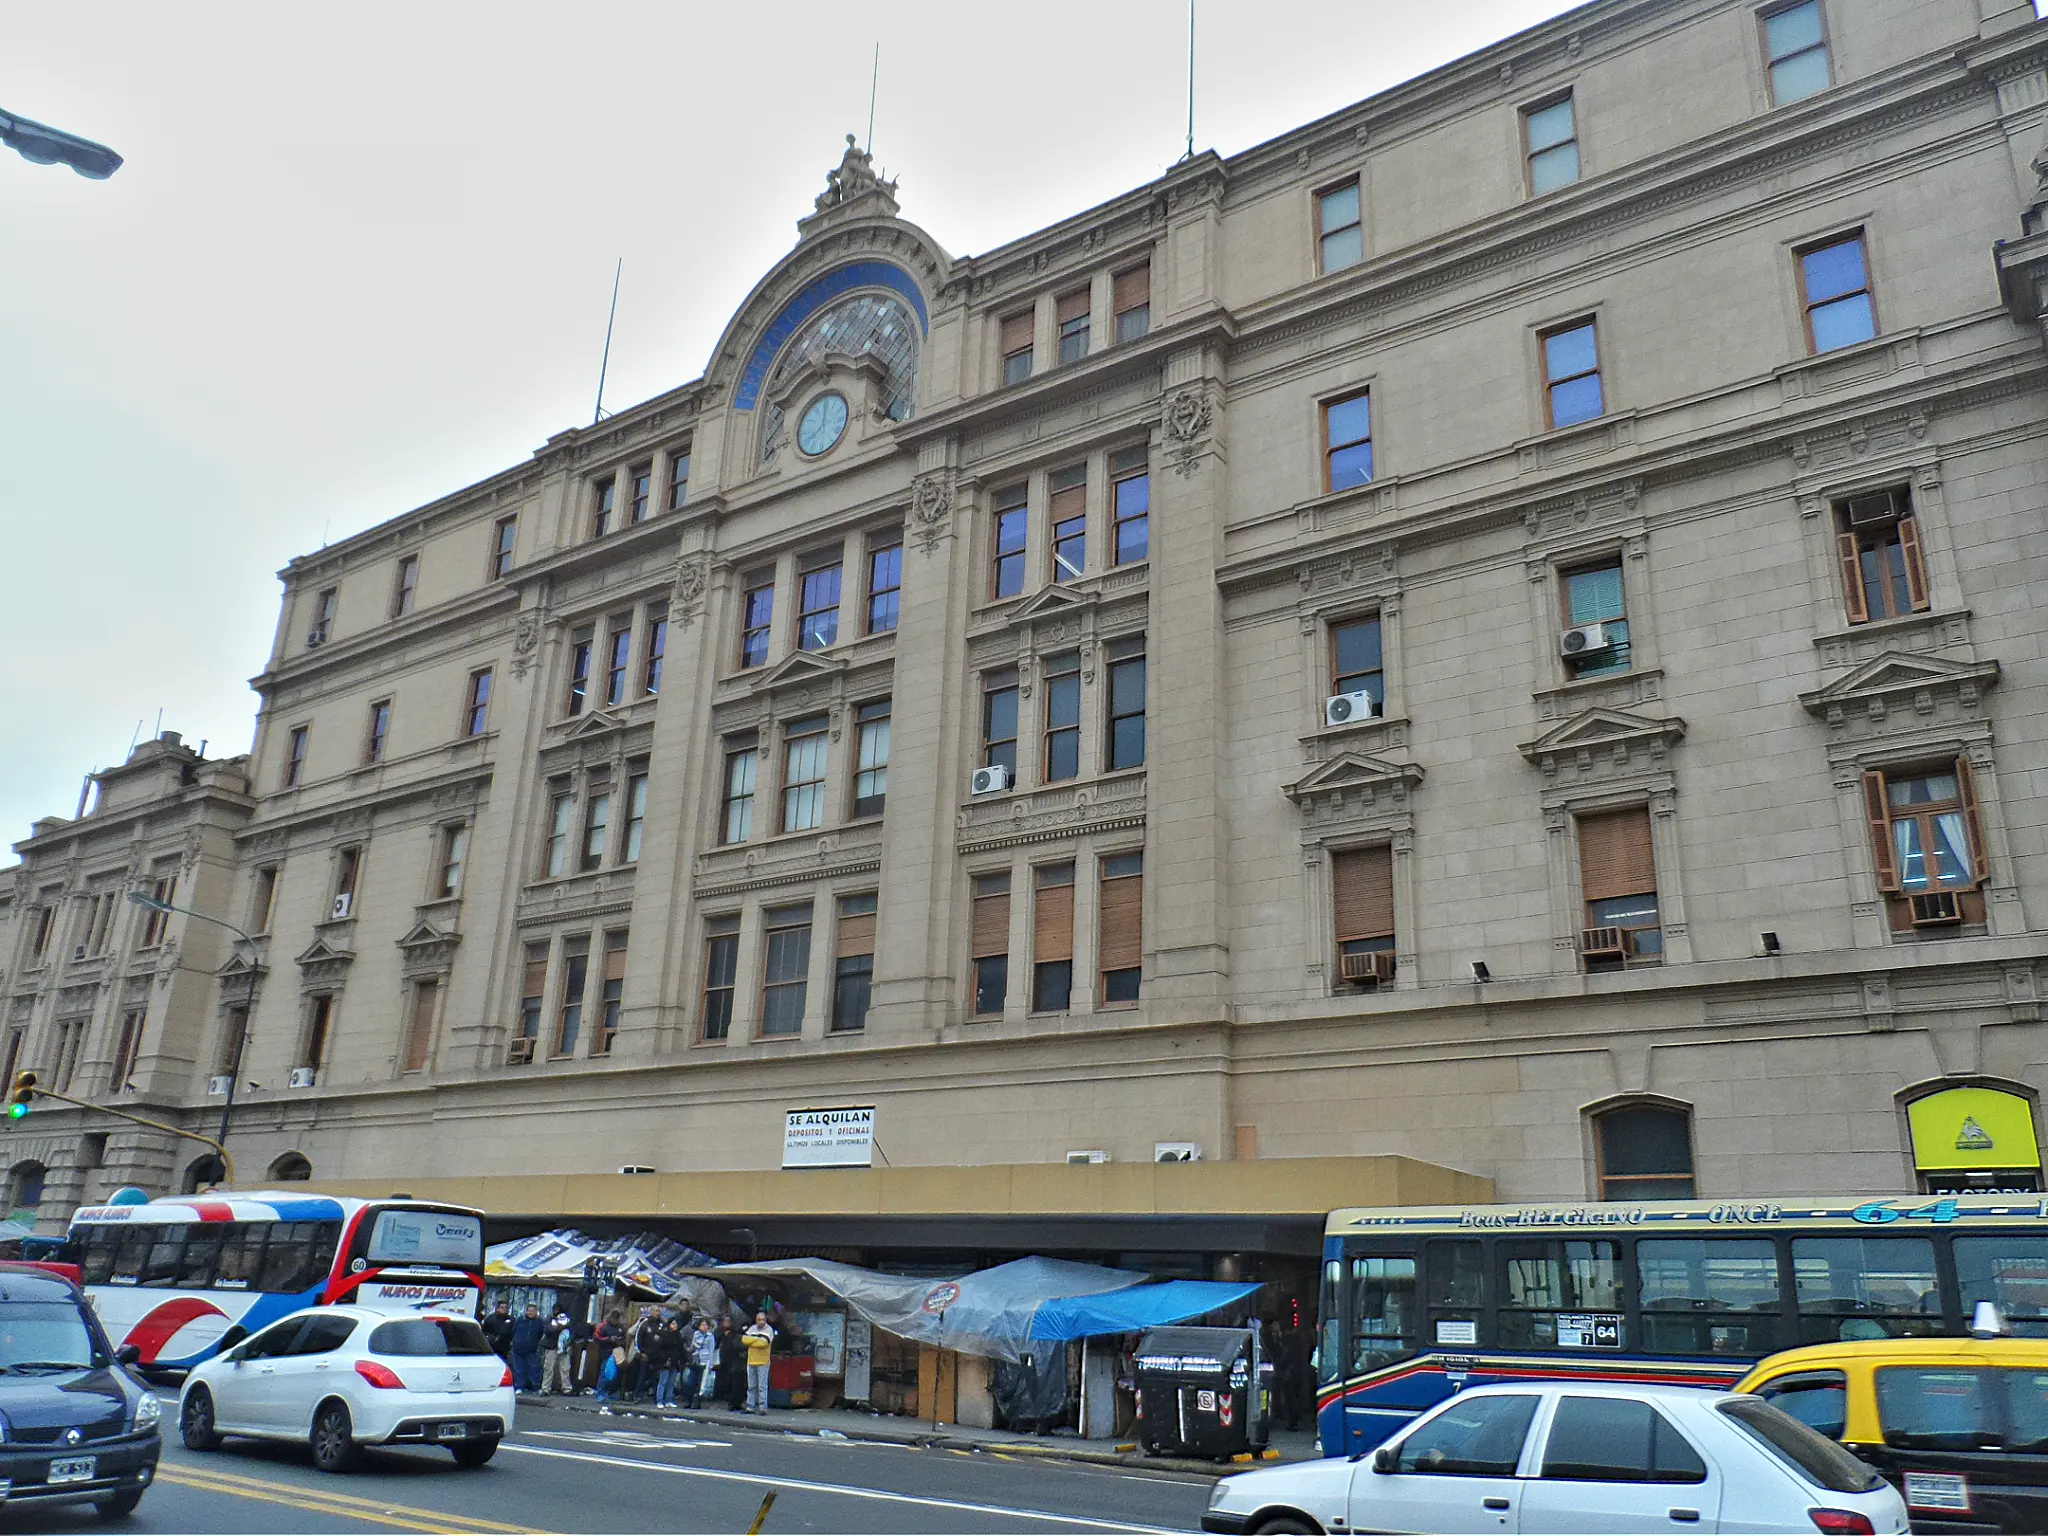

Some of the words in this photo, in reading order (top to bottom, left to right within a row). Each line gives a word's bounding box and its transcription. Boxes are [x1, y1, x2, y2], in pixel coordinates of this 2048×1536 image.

[789, 1115, 802, 1125] SE
[806, 1111, 871, 1125] ALQUILAN
[788, 1128, 823, 1137] DEPOSITOS
[837, 1126, 869, 1135] OFICINAS
[1515, 1207, 1647, 1226] BELGRANO
[1708, 1203, 1783, 1223] ONCE
[1852, 1199, 1959, 1224] 64
[353, 1261, 364, 1270] 60
[379, 1286, 422, 1298] NUEVOS
[423, 1287, 467, 1299] RUMBOS
[1596, 1325, 1616, 1338] 64
